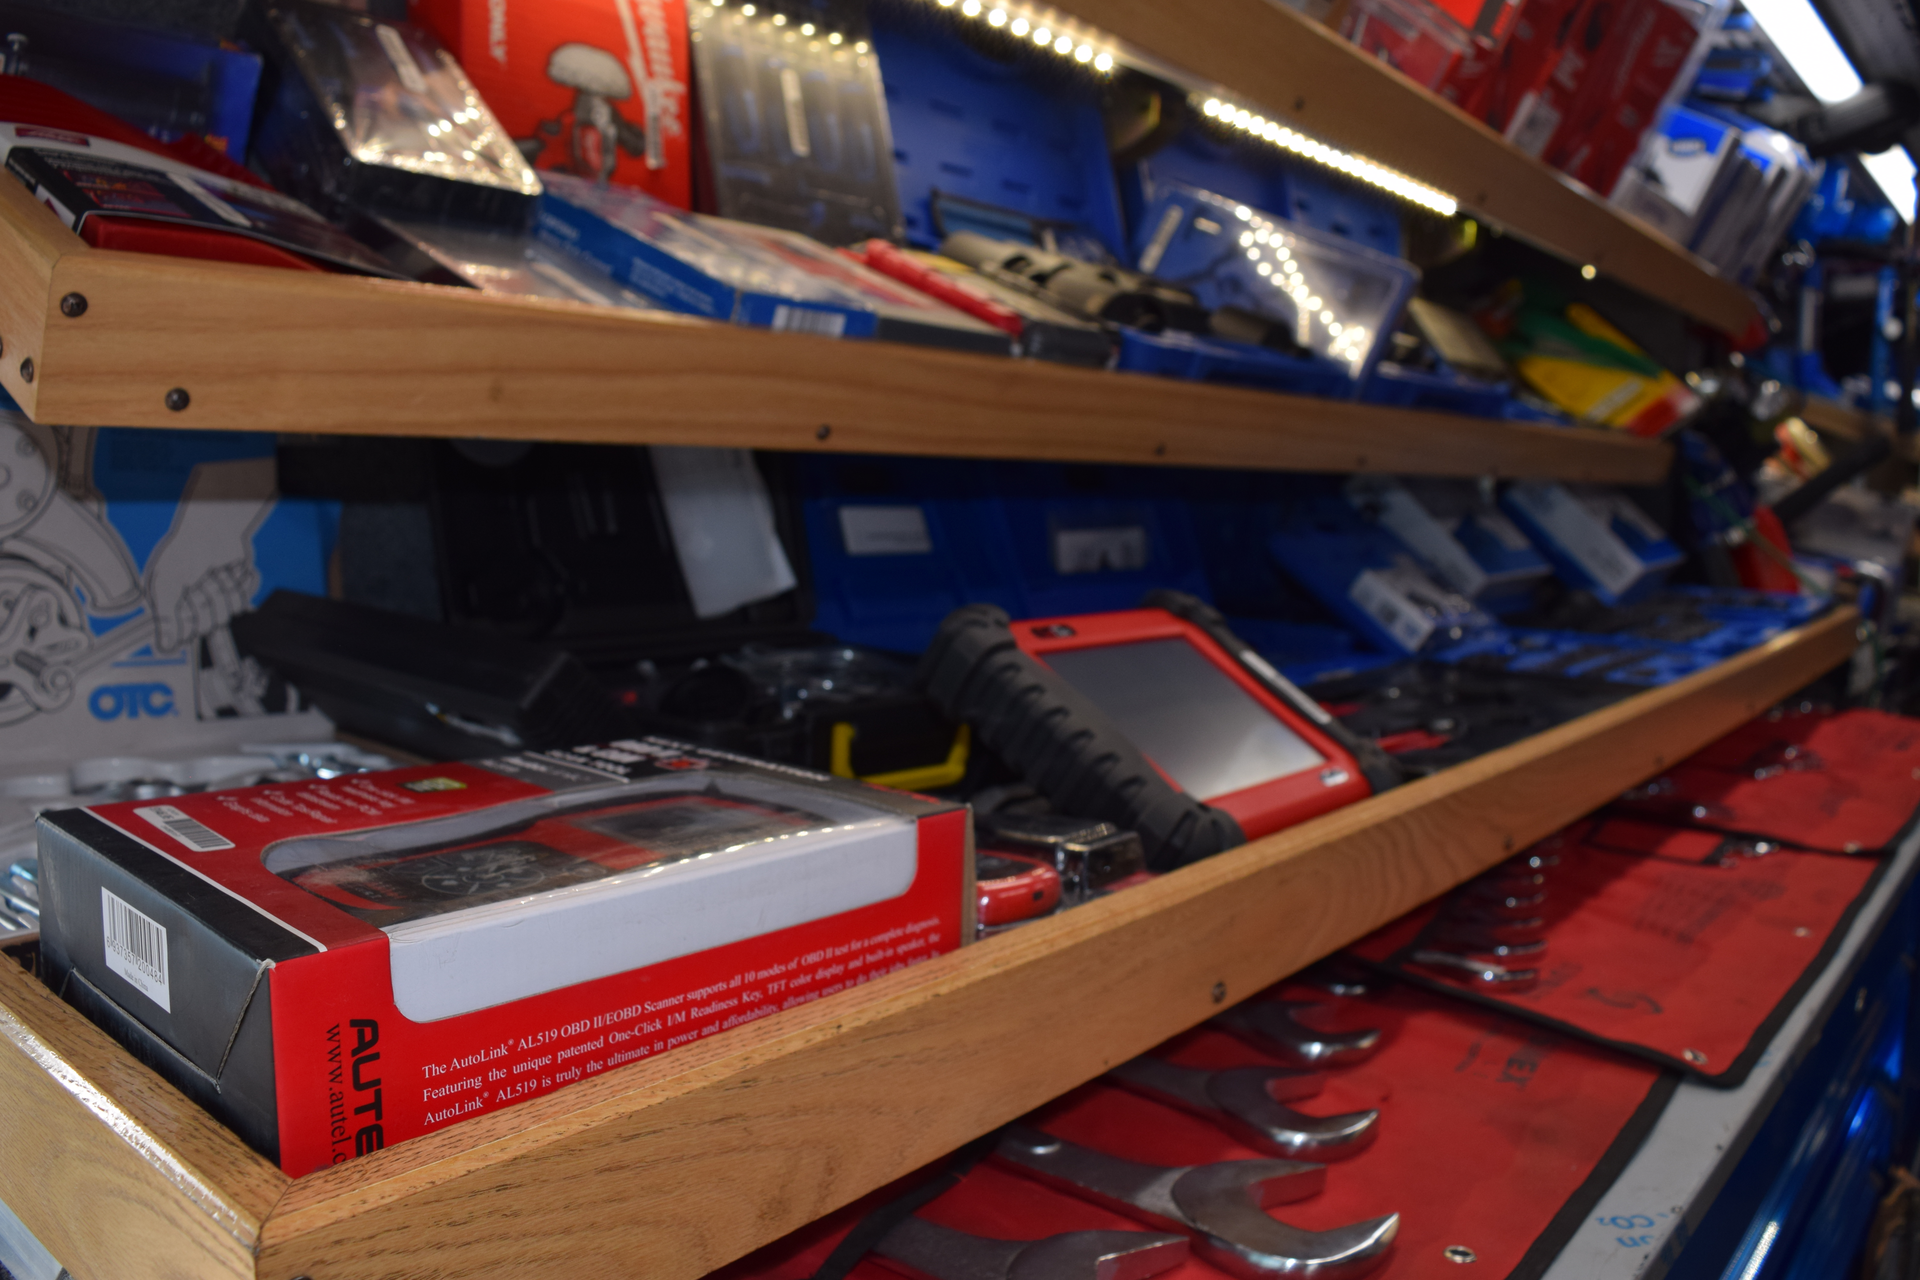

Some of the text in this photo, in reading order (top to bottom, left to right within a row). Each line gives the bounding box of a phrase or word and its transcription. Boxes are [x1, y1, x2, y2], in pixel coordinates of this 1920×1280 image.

[88, 682, 174, 721] OTC
[422, 1063, 447, 1079] The
[518, 1029, 558, 1051] AL519
[561, 1019, 591, 1038] OBD
[644, 993, 684, 1014] Scanner
[686, 982, 727, 1001] supports
[729, 974, 741, 988] all
[744, 971, 755, 983] 10
[757, 963, 786, 981] modes
[787, 956, 799, 971] of
[801, 950, 825, 967] OBD
[826, 946, 833, 960] II
[869, 926, 903, 945] complete
[422, 1075, 482, 1102] Featuring
[488, 1068, 507, 1082] the
[512, 1053, 552, 1075] unique
[557, 1035, 604, 1063] patented
[608, 1018, 663, 1045] One-Click
[667, 1010, 687, 1027] I/M
[690, 995, 738, 1019] Readiness
[741, 989, 763, 1004] Key,
[766, 979, 788, 996] TFT
[789, 971, 812, 988] color
[815, 962, 846, 980] display
[847, 956, 865, 970] and
[928, 932, 942, 945] the
[496, 1078, 537, 1103] AL519
[541, 1075, 552, 1088] is
[556, 1065, 582, 1084] truly
[586, 1060, 604, 1073] the
[607, 1044, 650, 1067] ultimate
[653, 1039, 665, 1051] in
[667, 1029, 698, 1051] power
[701, 1020, 719, 1036] and
[782, 989, 820, 1010] allowing
[821, 982, 843, 996] users
[845, 978, 856, 988] to
